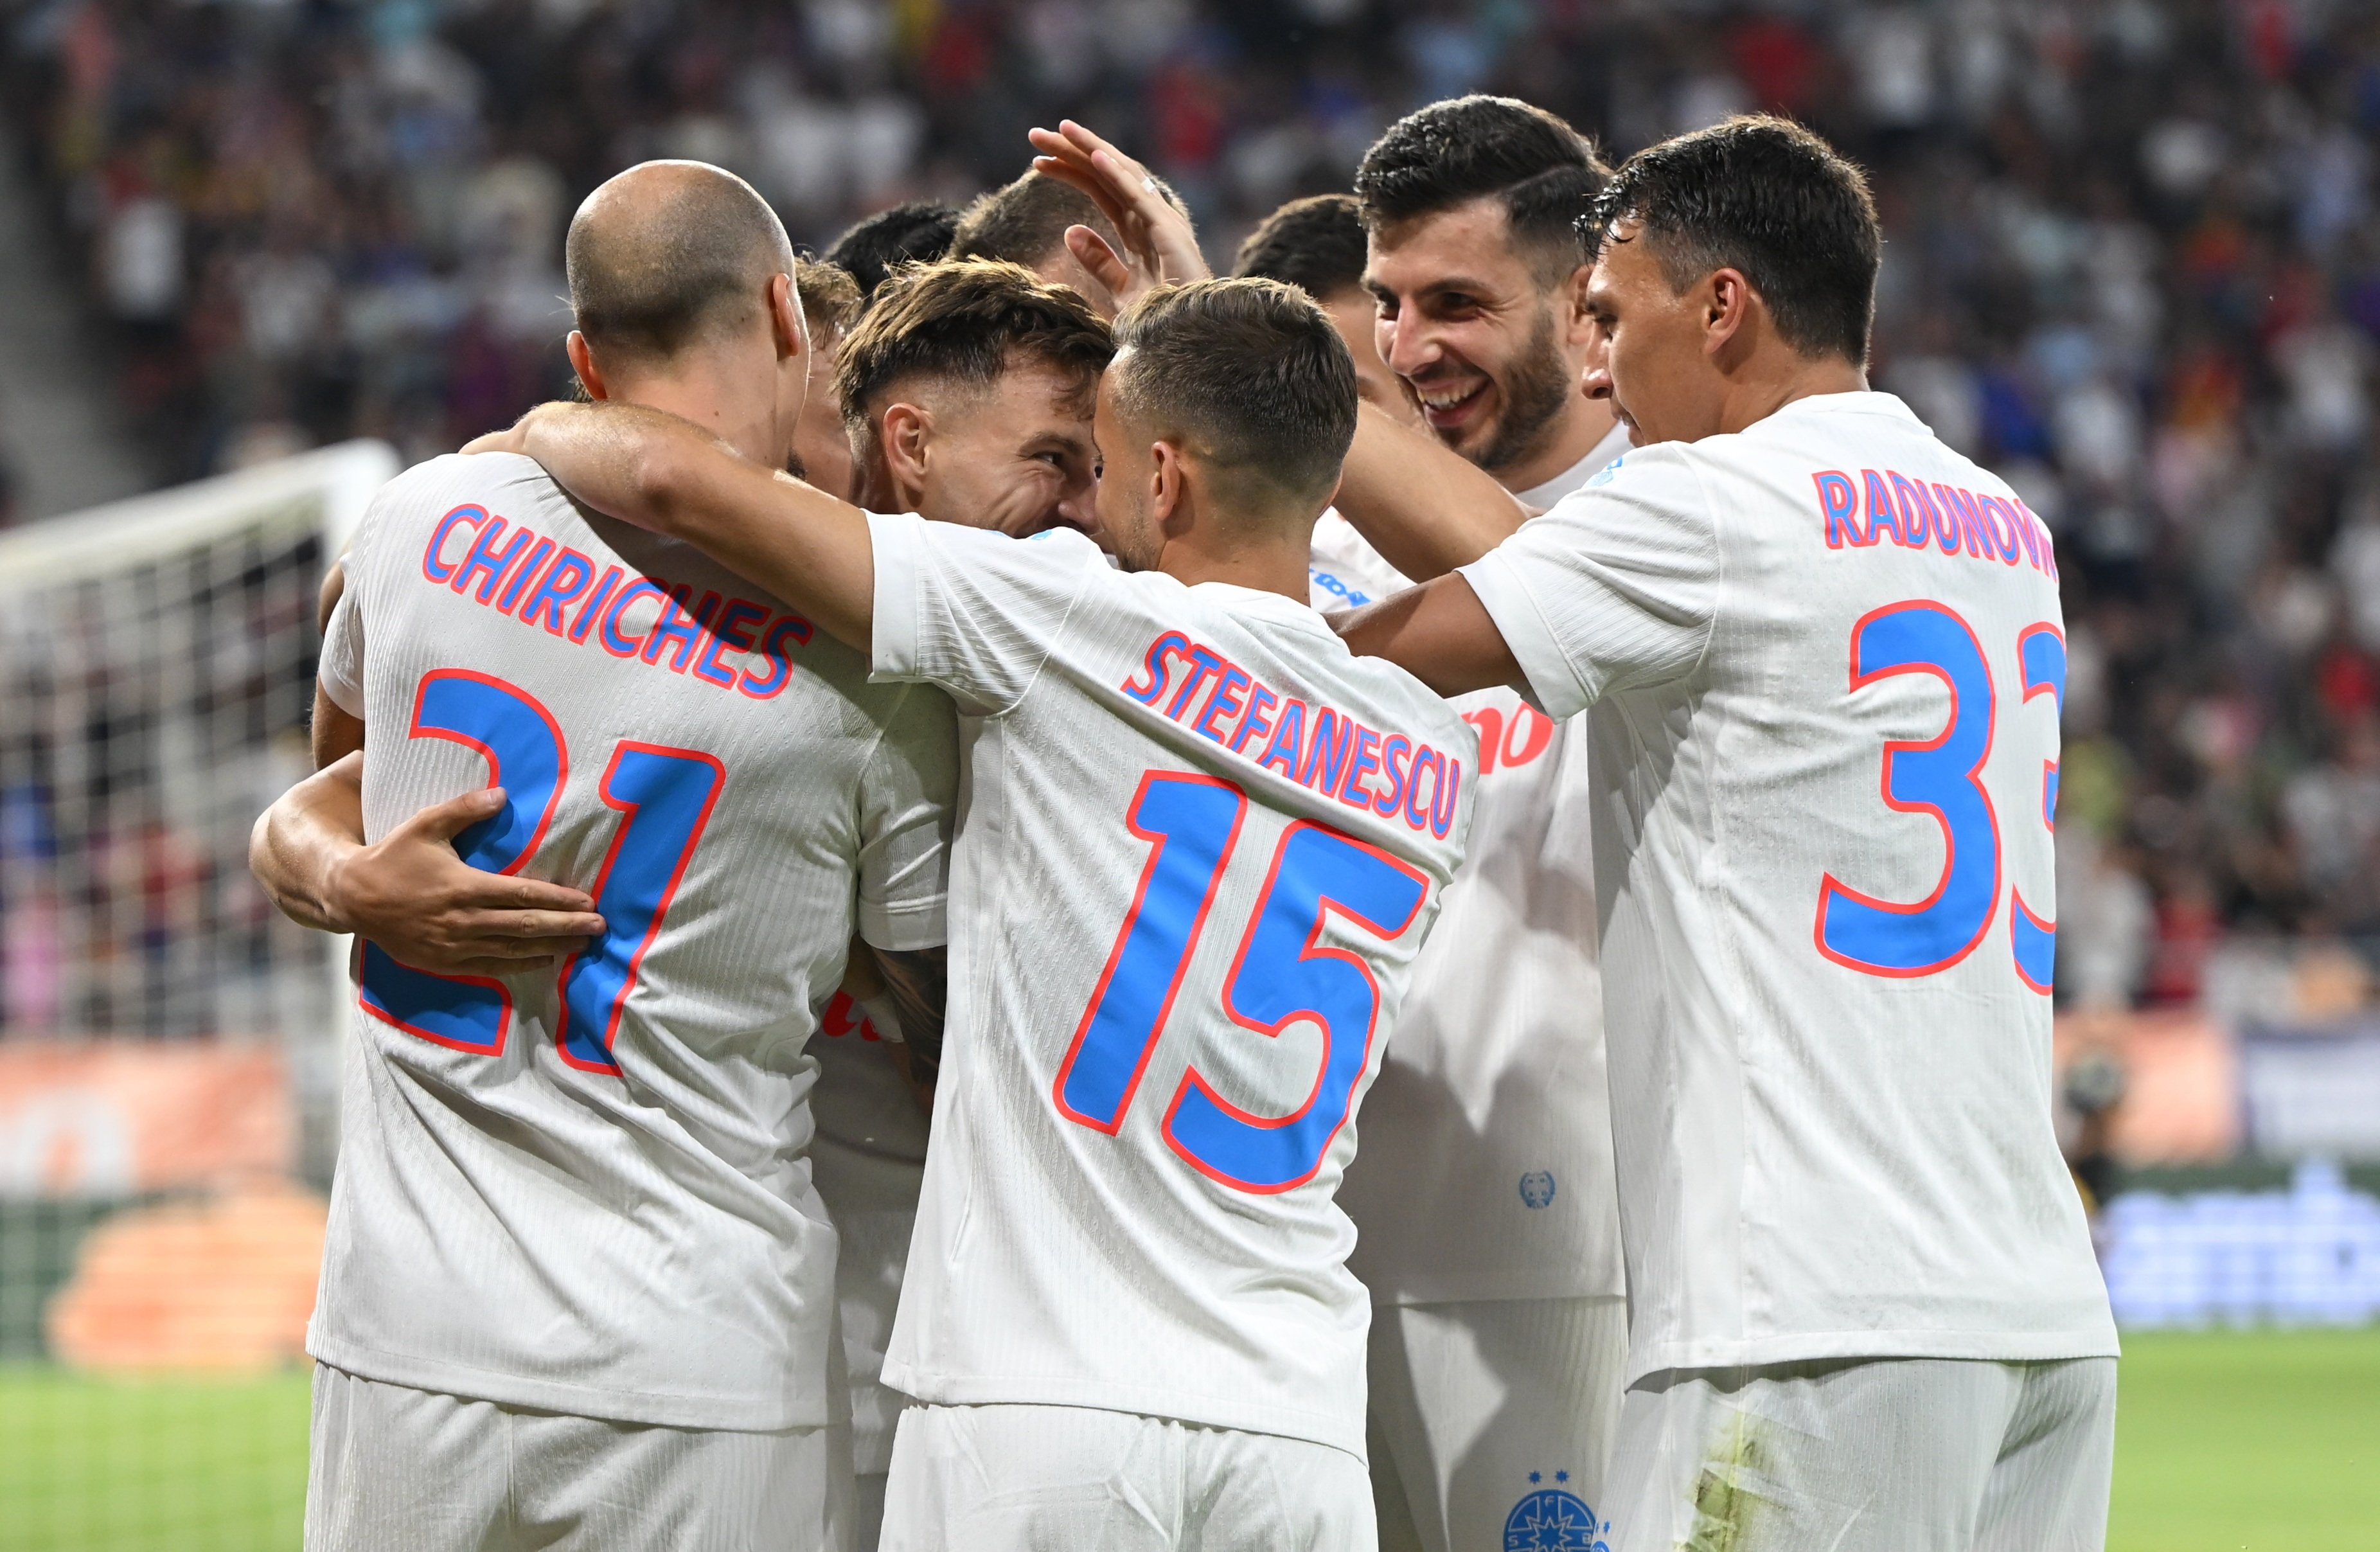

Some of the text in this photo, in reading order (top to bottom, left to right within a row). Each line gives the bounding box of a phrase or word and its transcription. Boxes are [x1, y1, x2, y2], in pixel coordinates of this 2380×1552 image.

[422, 503, 813, 699] CHIRICHES
[1121, 630, 1460, 841] STEFANESCU
[358, 668, 725, 1077] 21
[1052, 769, 1430, 1195] 15
